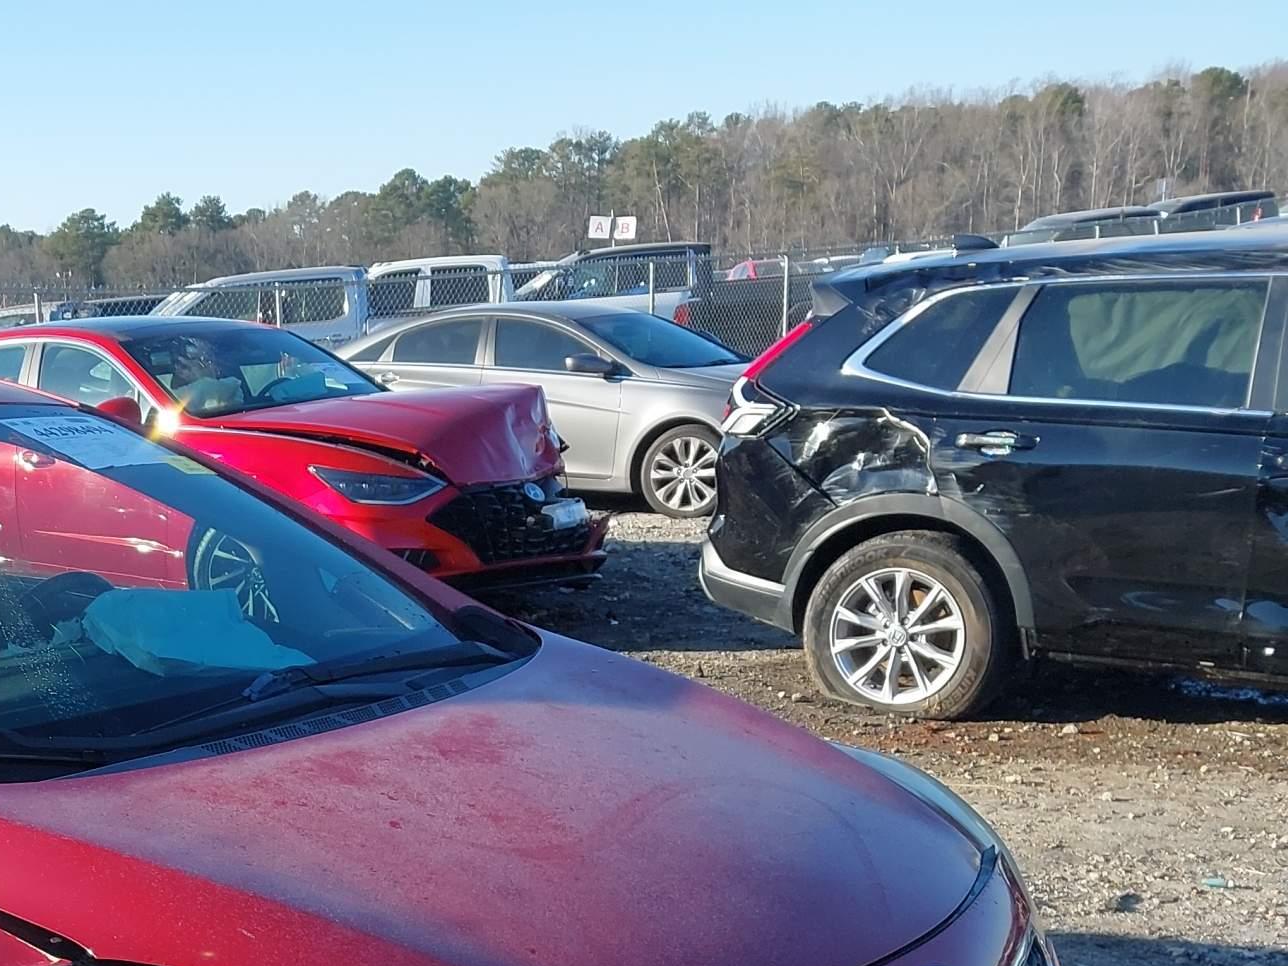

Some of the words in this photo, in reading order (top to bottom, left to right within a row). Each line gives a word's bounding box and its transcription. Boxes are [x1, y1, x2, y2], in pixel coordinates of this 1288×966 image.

[595, 221, 604, 233] A
[620, 222, 630, 234] B
[32, 425, 116, 438] 44298494
